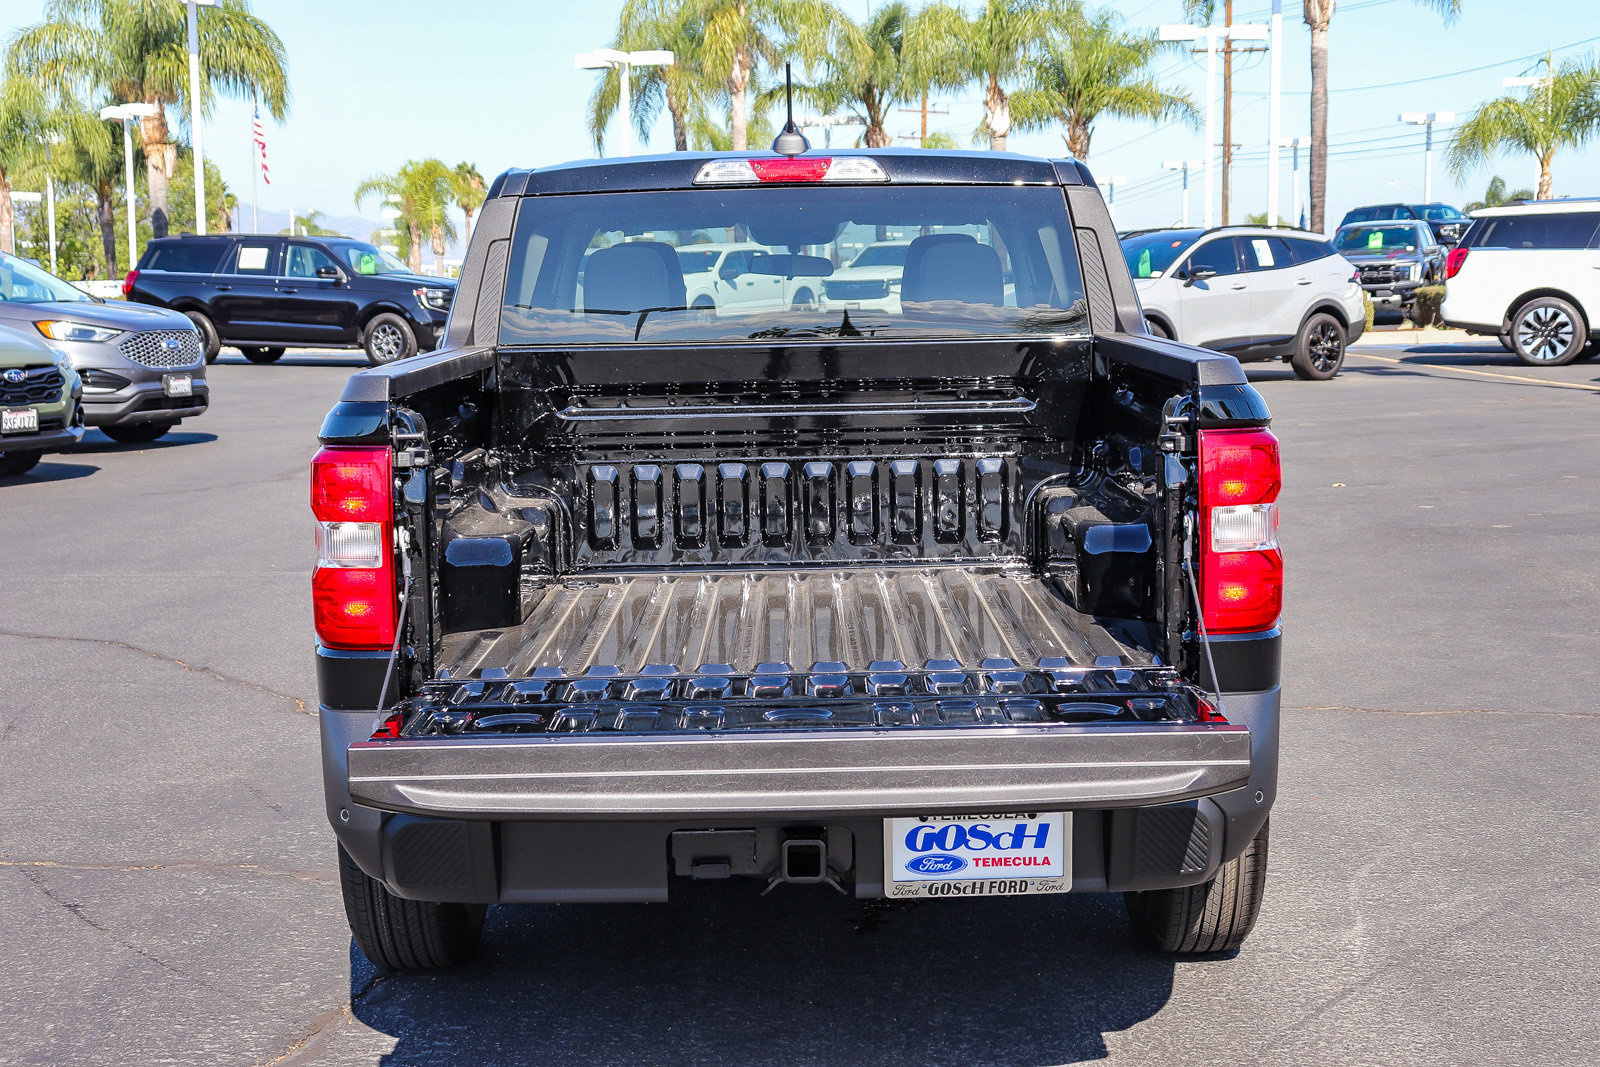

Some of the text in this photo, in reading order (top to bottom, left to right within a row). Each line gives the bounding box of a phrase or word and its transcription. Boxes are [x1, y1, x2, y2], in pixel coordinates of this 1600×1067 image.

[973, 856, 1051, 867] TEMECULA
[892, 884, 921, 896] Ford
[988, 880, 1029, 894] FORD
[1036, 880, 1064, 892] Ford
